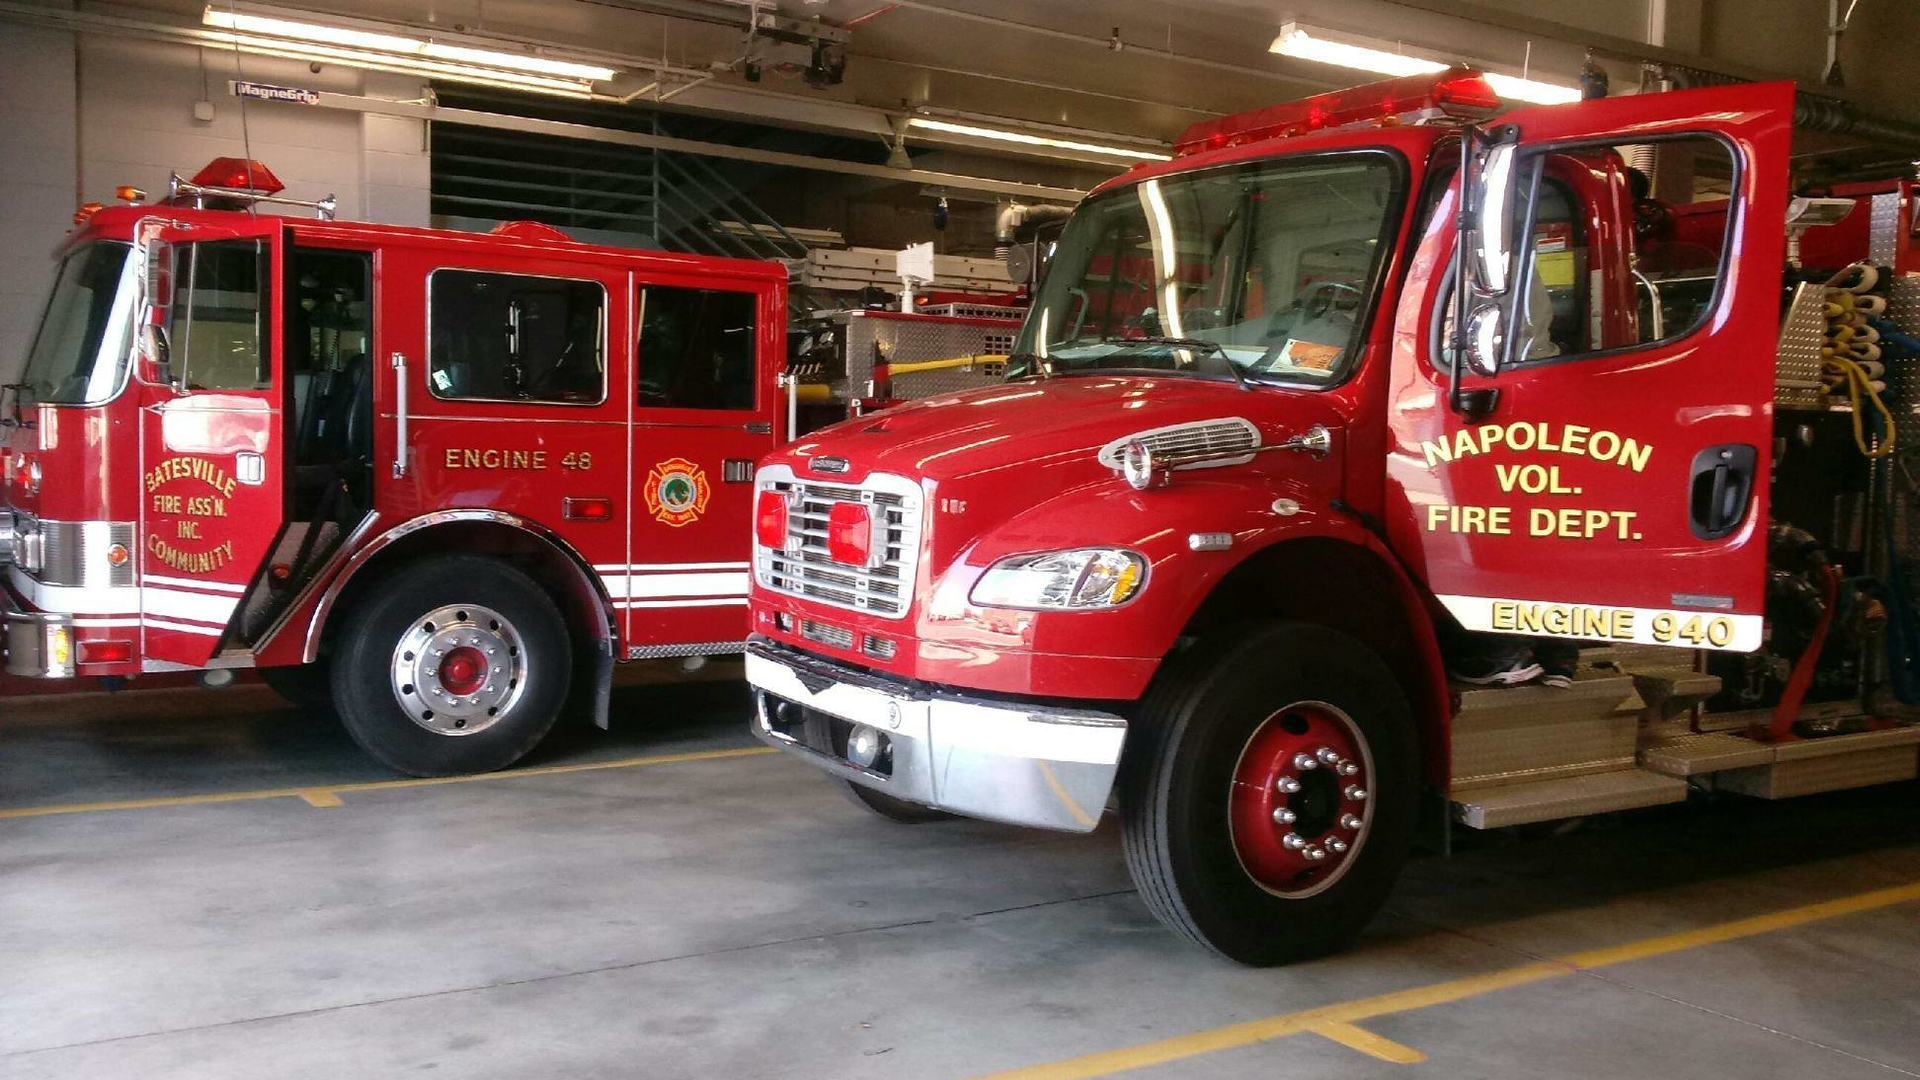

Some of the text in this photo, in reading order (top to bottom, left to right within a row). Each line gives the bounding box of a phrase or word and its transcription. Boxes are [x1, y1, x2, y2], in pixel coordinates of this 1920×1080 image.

[238, 83, 318, 106] MagneGrip
[445, 449, 592, 470] ENGINE 48
[1421, 421, 1653, 472] NAPOLEON
[145, 457, 236, 499] BATESVILLE
[1495, 464, 1582, 494] VOL.
[154, 495, 181, 513] FIRE
[177, 521, 202, 539] INC.
[1427, 505, 1642, 540] FIRE DEPT.
[148, 534, 233, 573] COMMUNITY
[1492, 601, 1735, 647] ENGINE 940
